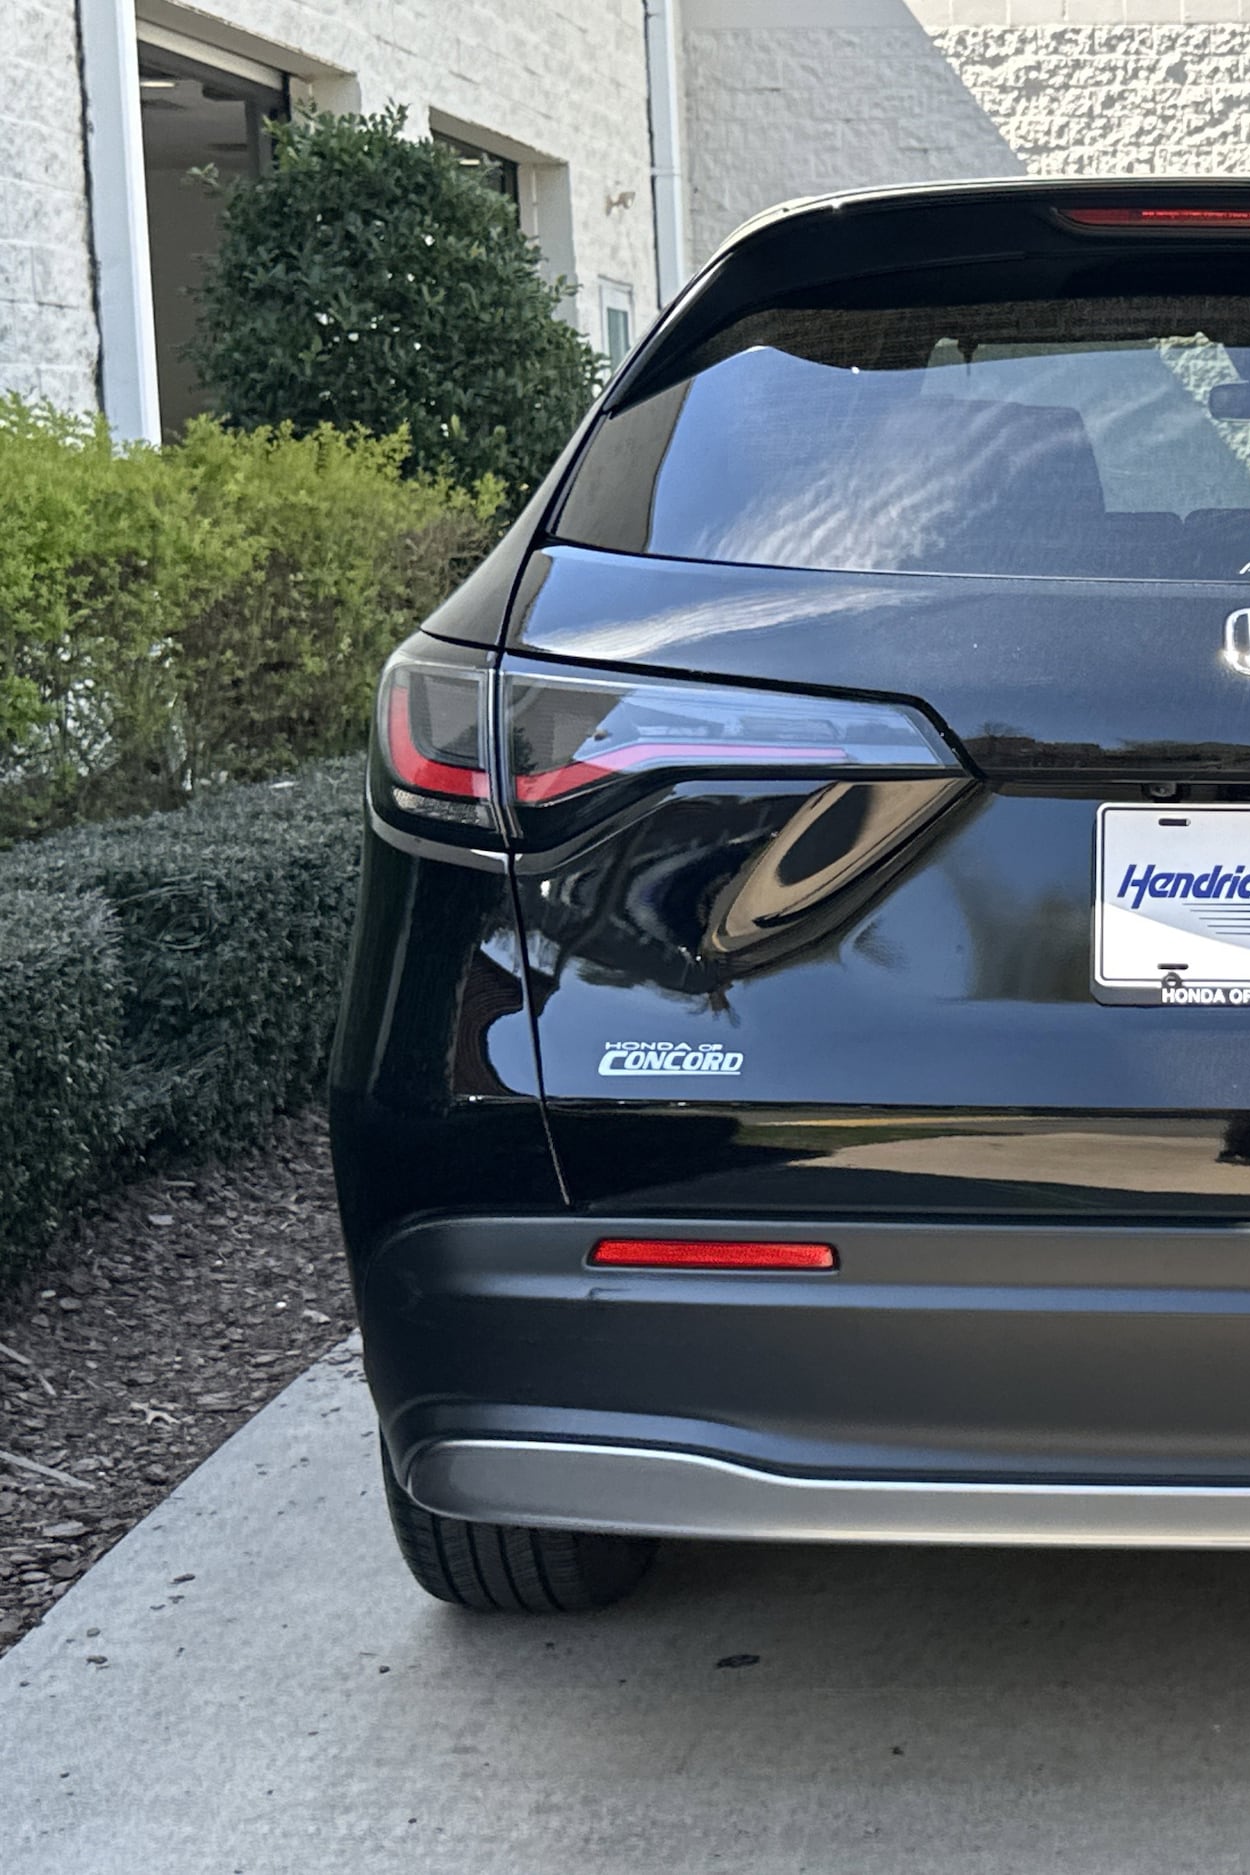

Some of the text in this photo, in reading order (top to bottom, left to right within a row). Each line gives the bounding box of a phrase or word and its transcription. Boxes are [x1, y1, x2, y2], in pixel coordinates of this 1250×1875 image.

[1162, 988, 1225, 1005] HONDA
[605, 1041, 723, 1051] HONDA OF
[598, 1050, 744, 1076] CONCORD
